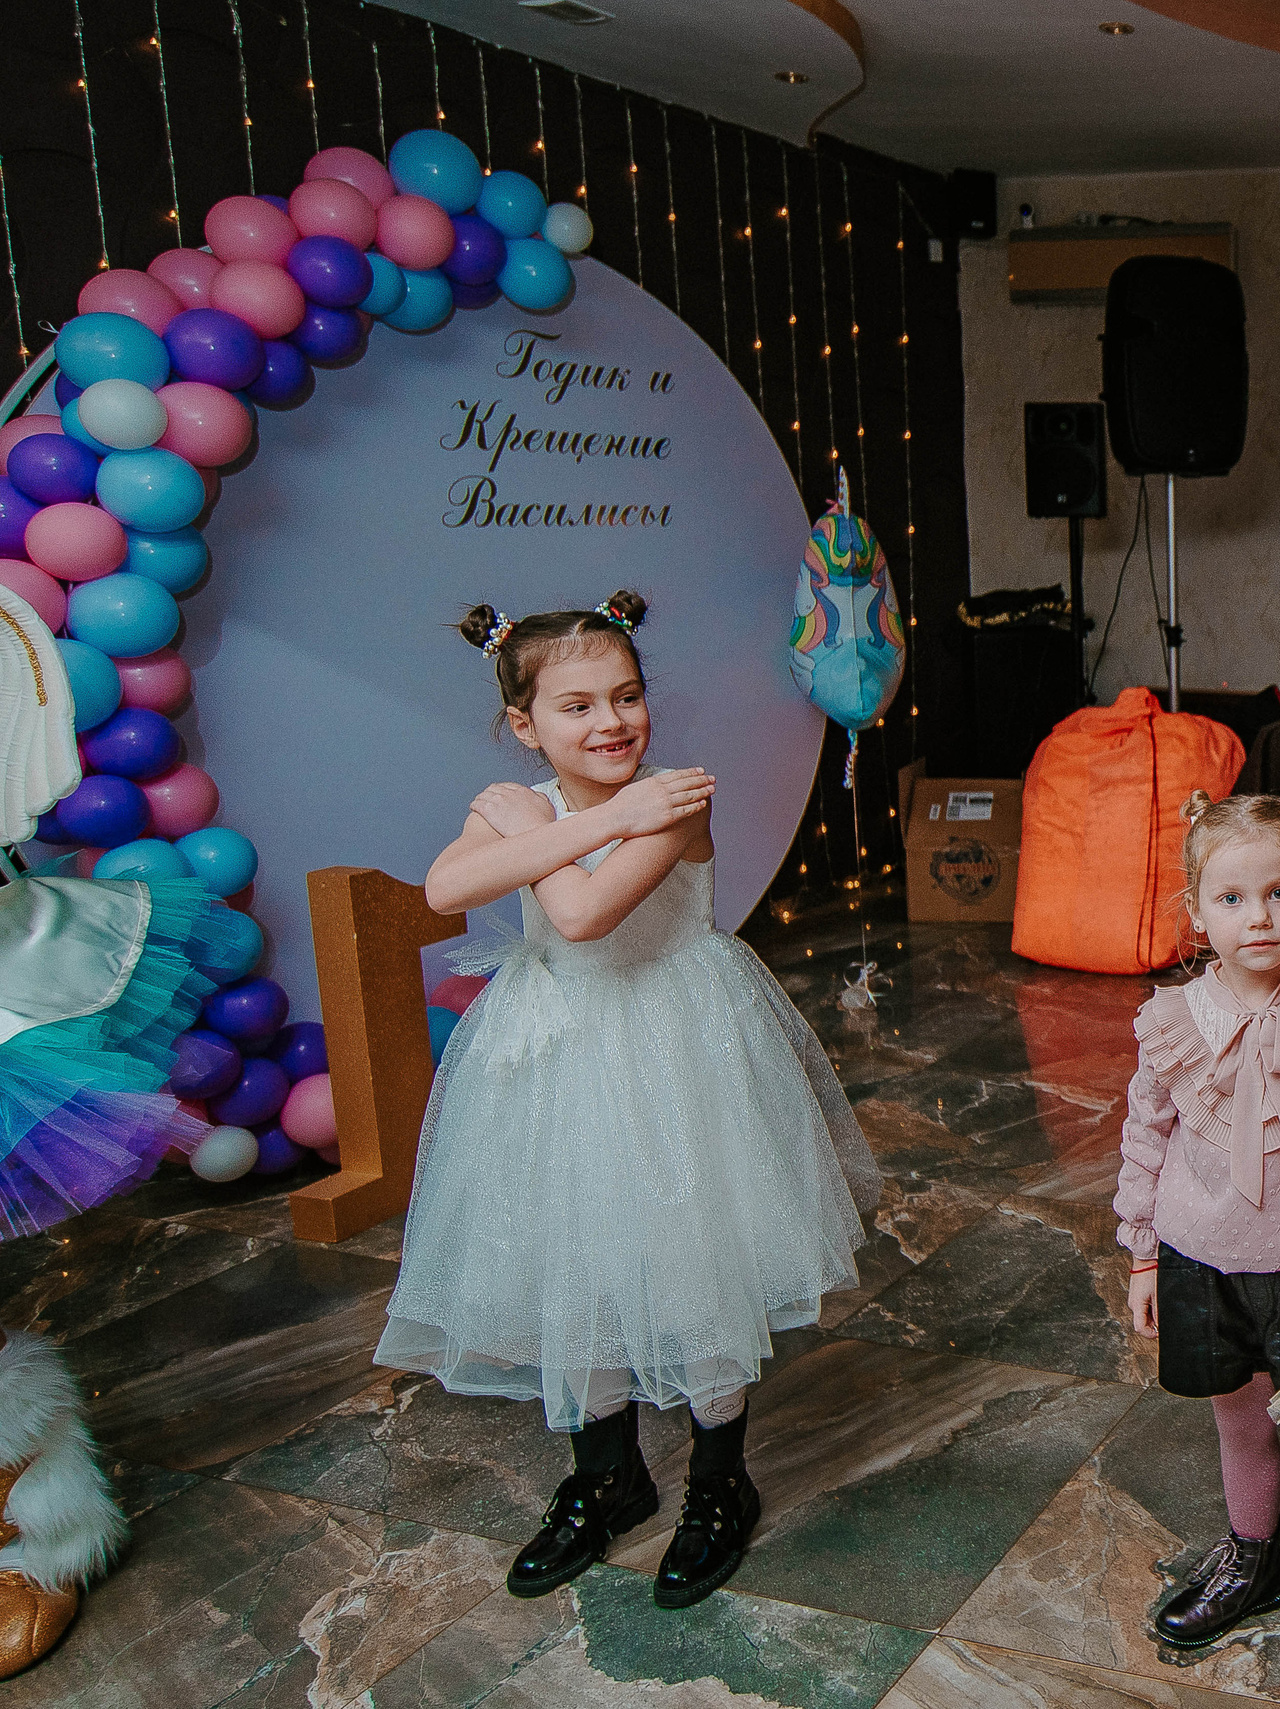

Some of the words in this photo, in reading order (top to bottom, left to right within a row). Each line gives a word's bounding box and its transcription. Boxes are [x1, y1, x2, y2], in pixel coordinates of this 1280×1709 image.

[496, 329, 631, 405] Годик
[649, 370, 675, 394] и
[440, 399, 673, 474] Крещение
[441, 474, 673, 529] Василисы
